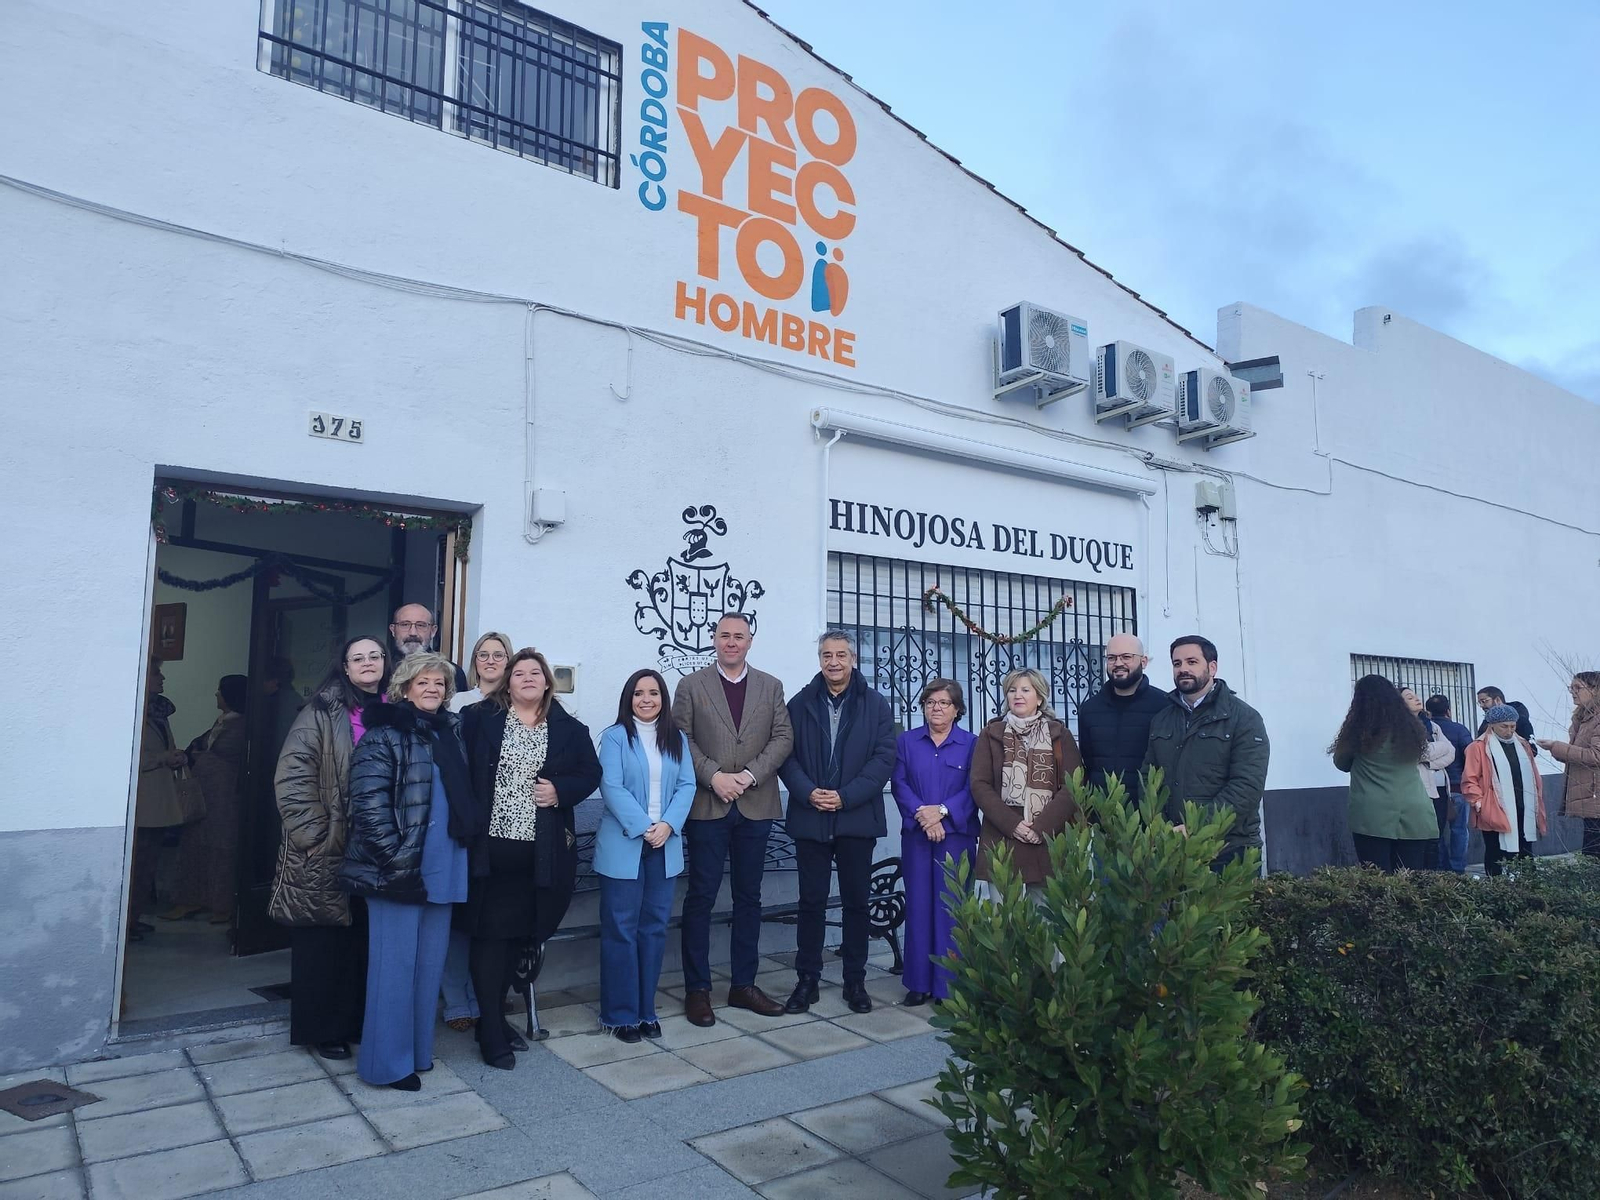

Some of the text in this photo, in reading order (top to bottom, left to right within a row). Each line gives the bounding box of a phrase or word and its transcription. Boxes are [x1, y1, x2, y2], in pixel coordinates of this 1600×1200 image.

[629, 21, 669, 212] CÓRDOBA
[676, 27, 857, 167] PRO
[675, 281, 857, 368] HOMBRE
[828, 498, 1134, 574] HINOJOSA DEL DUQUE
